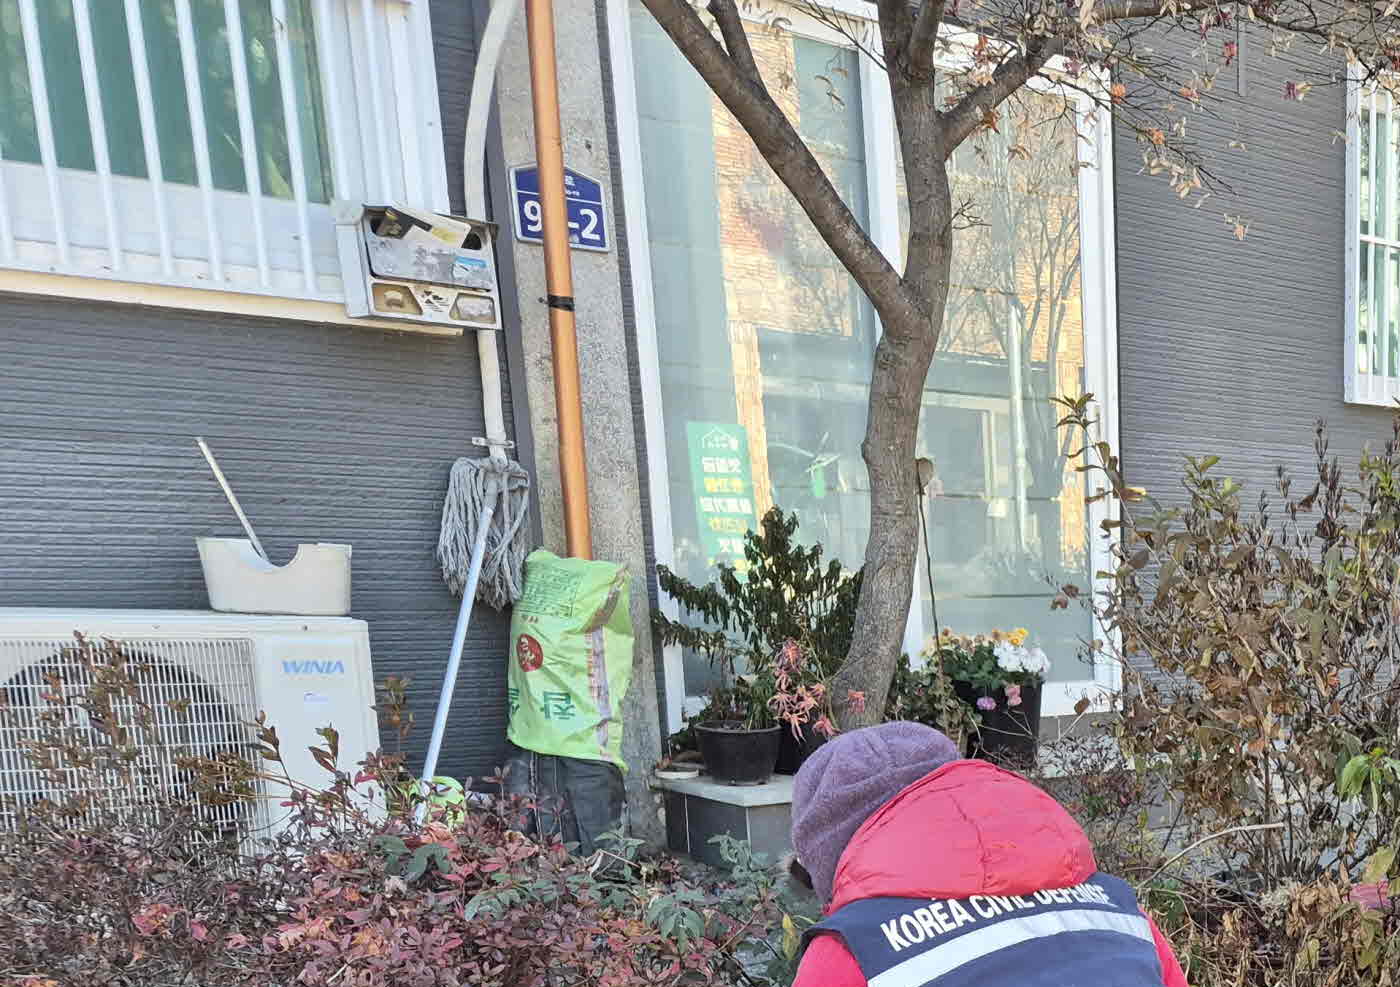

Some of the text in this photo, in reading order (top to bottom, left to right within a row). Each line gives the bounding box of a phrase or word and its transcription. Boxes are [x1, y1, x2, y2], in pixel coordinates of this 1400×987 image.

[523, 199, 601, 240] 9-2
[281, 660, 344, 673] WINIA
[880, 898, 976, 952] KOREA
